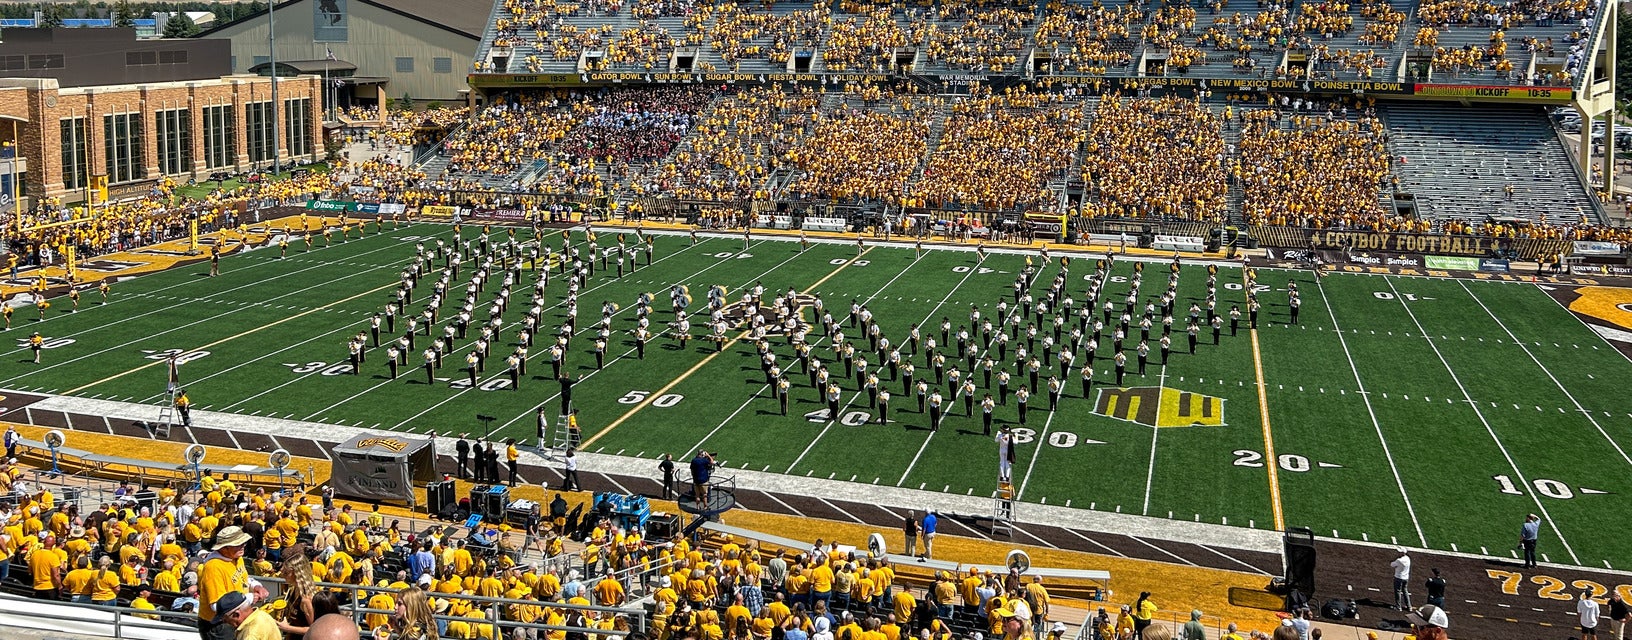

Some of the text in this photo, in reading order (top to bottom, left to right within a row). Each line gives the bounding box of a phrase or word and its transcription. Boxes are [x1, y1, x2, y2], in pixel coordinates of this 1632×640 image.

[591, 73, 618, 81] GATOR
[671, 73, 694, 81] BOWL
[1210, 79, 1231, 87] NEW
[1271, 80, 1298, 88] BOWL
[1314, 81, 1403, 91] POINSETTIA BOWL
[1475, 88, 1510, 97] KICKOFF
[1527, 89, 1551, 98] 10:35
[109, 188, 125, 196] HIGH
[1396, 234, 1486, 255] FOOTBALL
[1350, 255, 1381, 265] Simplot
[1387, 257, 1418, 267] Simplot
[292, 361, 355, 376] 30
[617, 390, 685, 408] 50
[804, 408, 871, 427] 40
[1009, 428, 1078, 448] 30
[1232, 449, 1311, 472] 20
[1492, 474, 1574, 500] 10
